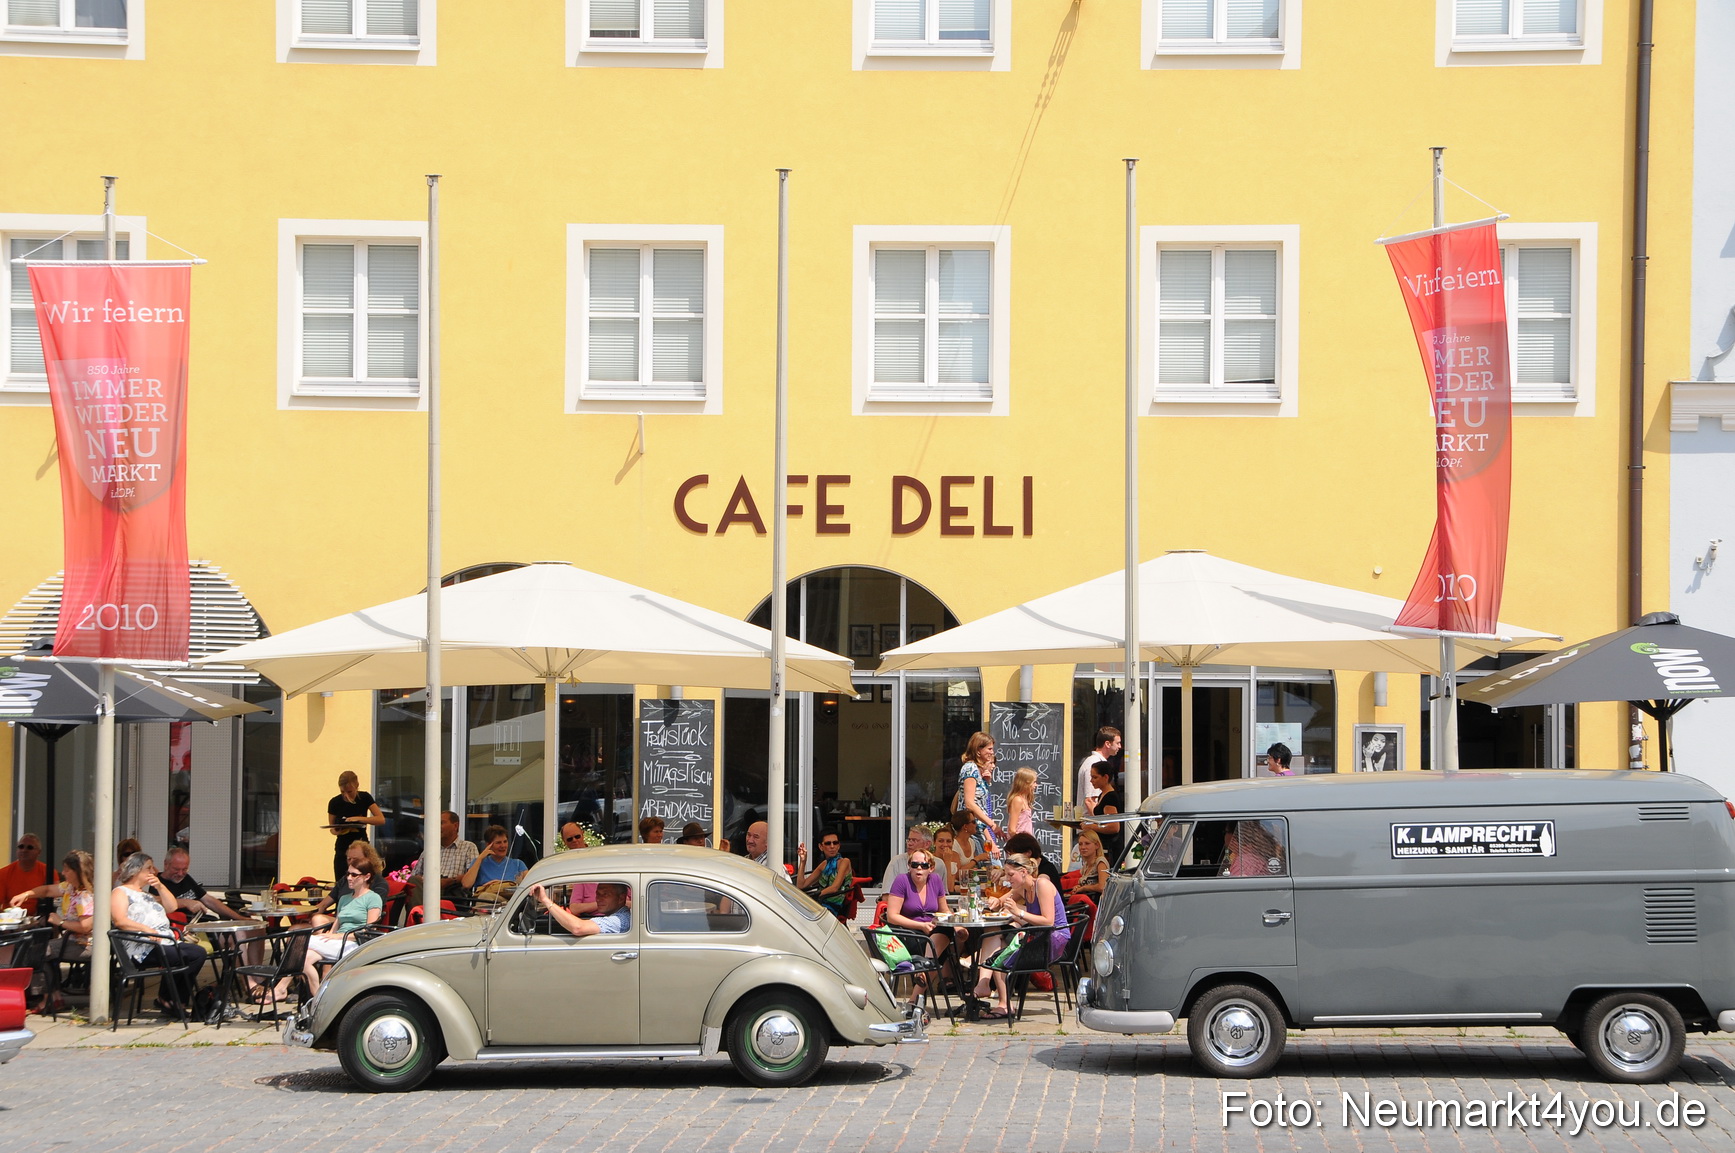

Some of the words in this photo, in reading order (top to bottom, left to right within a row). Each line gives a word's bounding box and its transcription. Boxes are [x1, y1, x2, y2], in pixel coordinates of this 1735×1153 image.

[1434, 267, 1501, 293] feiern
[42, 300, 94, 324] Wir
[103, 298, 185, 323] feiern
[1439, 333, 1471, 344] Jahre
[1435, 346, 1491, 368] MER
[87, 365, 109, 375] 850
[111, 364, 140, 375] Jahre
[72, 378, 163, 400] IMMER
[1435, 371, 1495, 393] EDER
[74, 403, 168, 424] WIEDER
[1436, 397, 1489, 428] EU
[84, 427, 161, 459] NEU
[91, 463, 161, 483] MARKT
[674, 473, 851, 534] CAFE
[891, 475, 1034, 535] DELI
[75, 603, 159, 631] 2010
[1019, 746, 1034, 760] bis
[1396, 827, 1416, 844] K.
[1421, 825, 1536, 844] LAMPRECHT
[1397, 846, 1438, 855] HEIZUNG
[1444, 844, 1485, 854] SANITÄR
